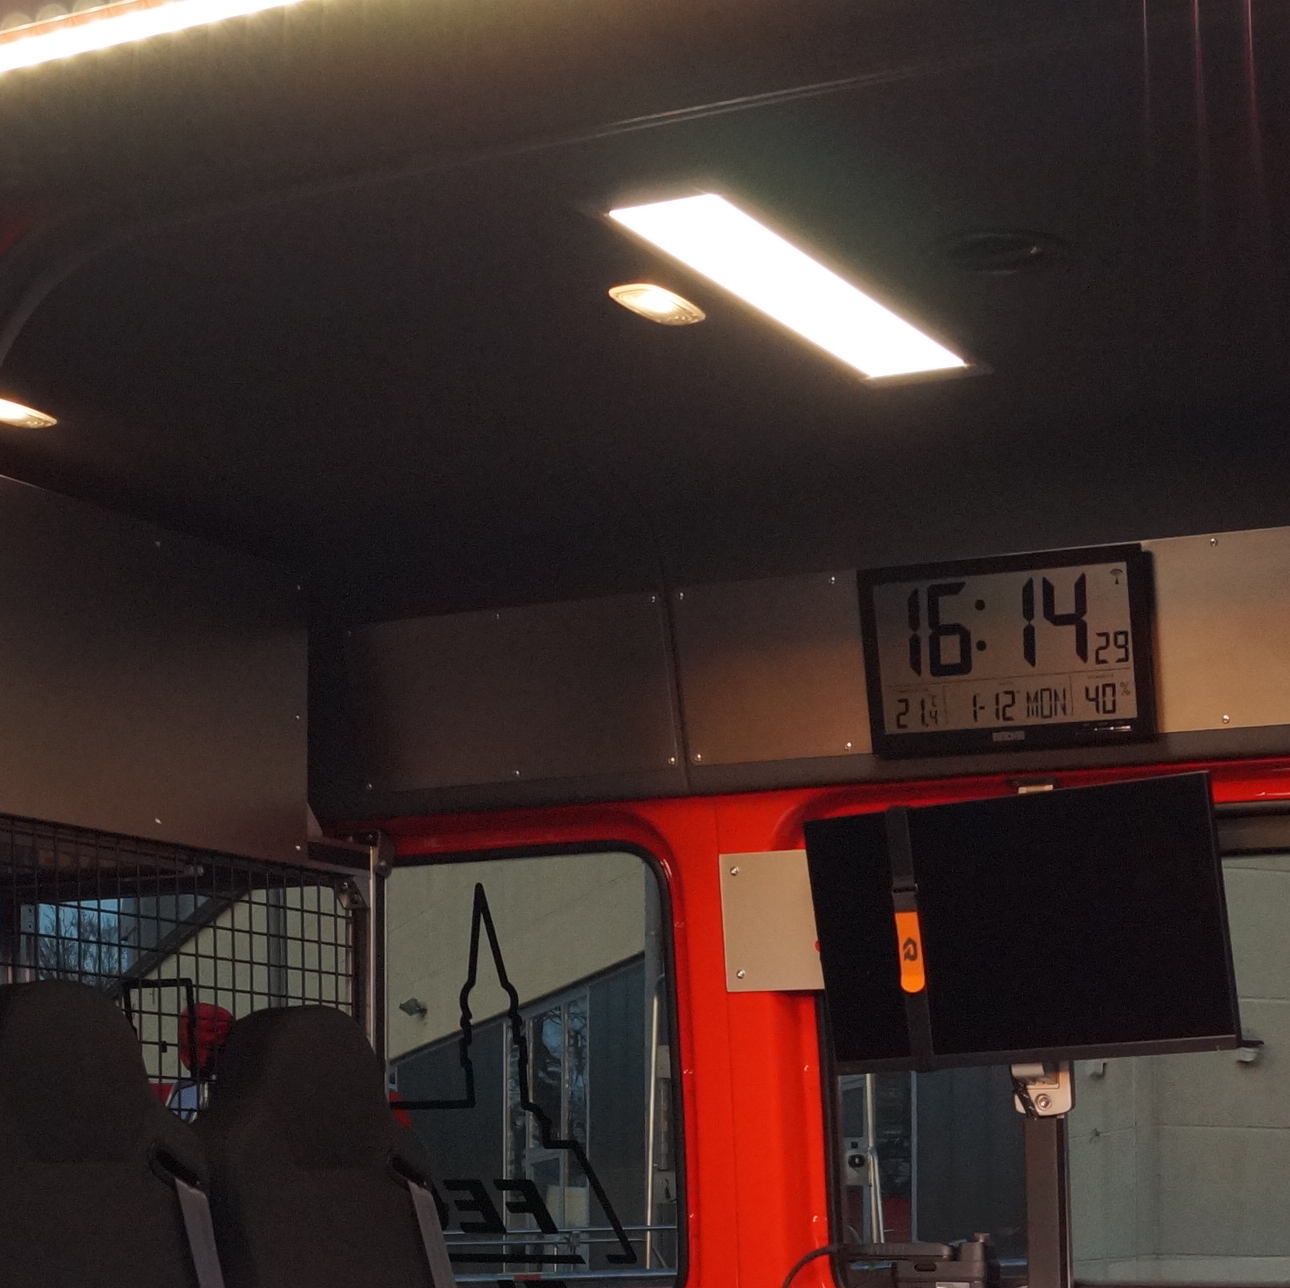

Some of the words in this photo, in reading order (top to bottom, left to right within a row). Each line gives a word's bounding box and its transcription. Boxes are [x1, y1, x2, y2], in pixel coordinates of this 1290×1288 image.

[907, 572, 1088, 677] 16:14
[1095, 630, 1130, 665] 29
[972, 690, 1017, 722] 1-12
[1026, 687, 1067, 718] MON
